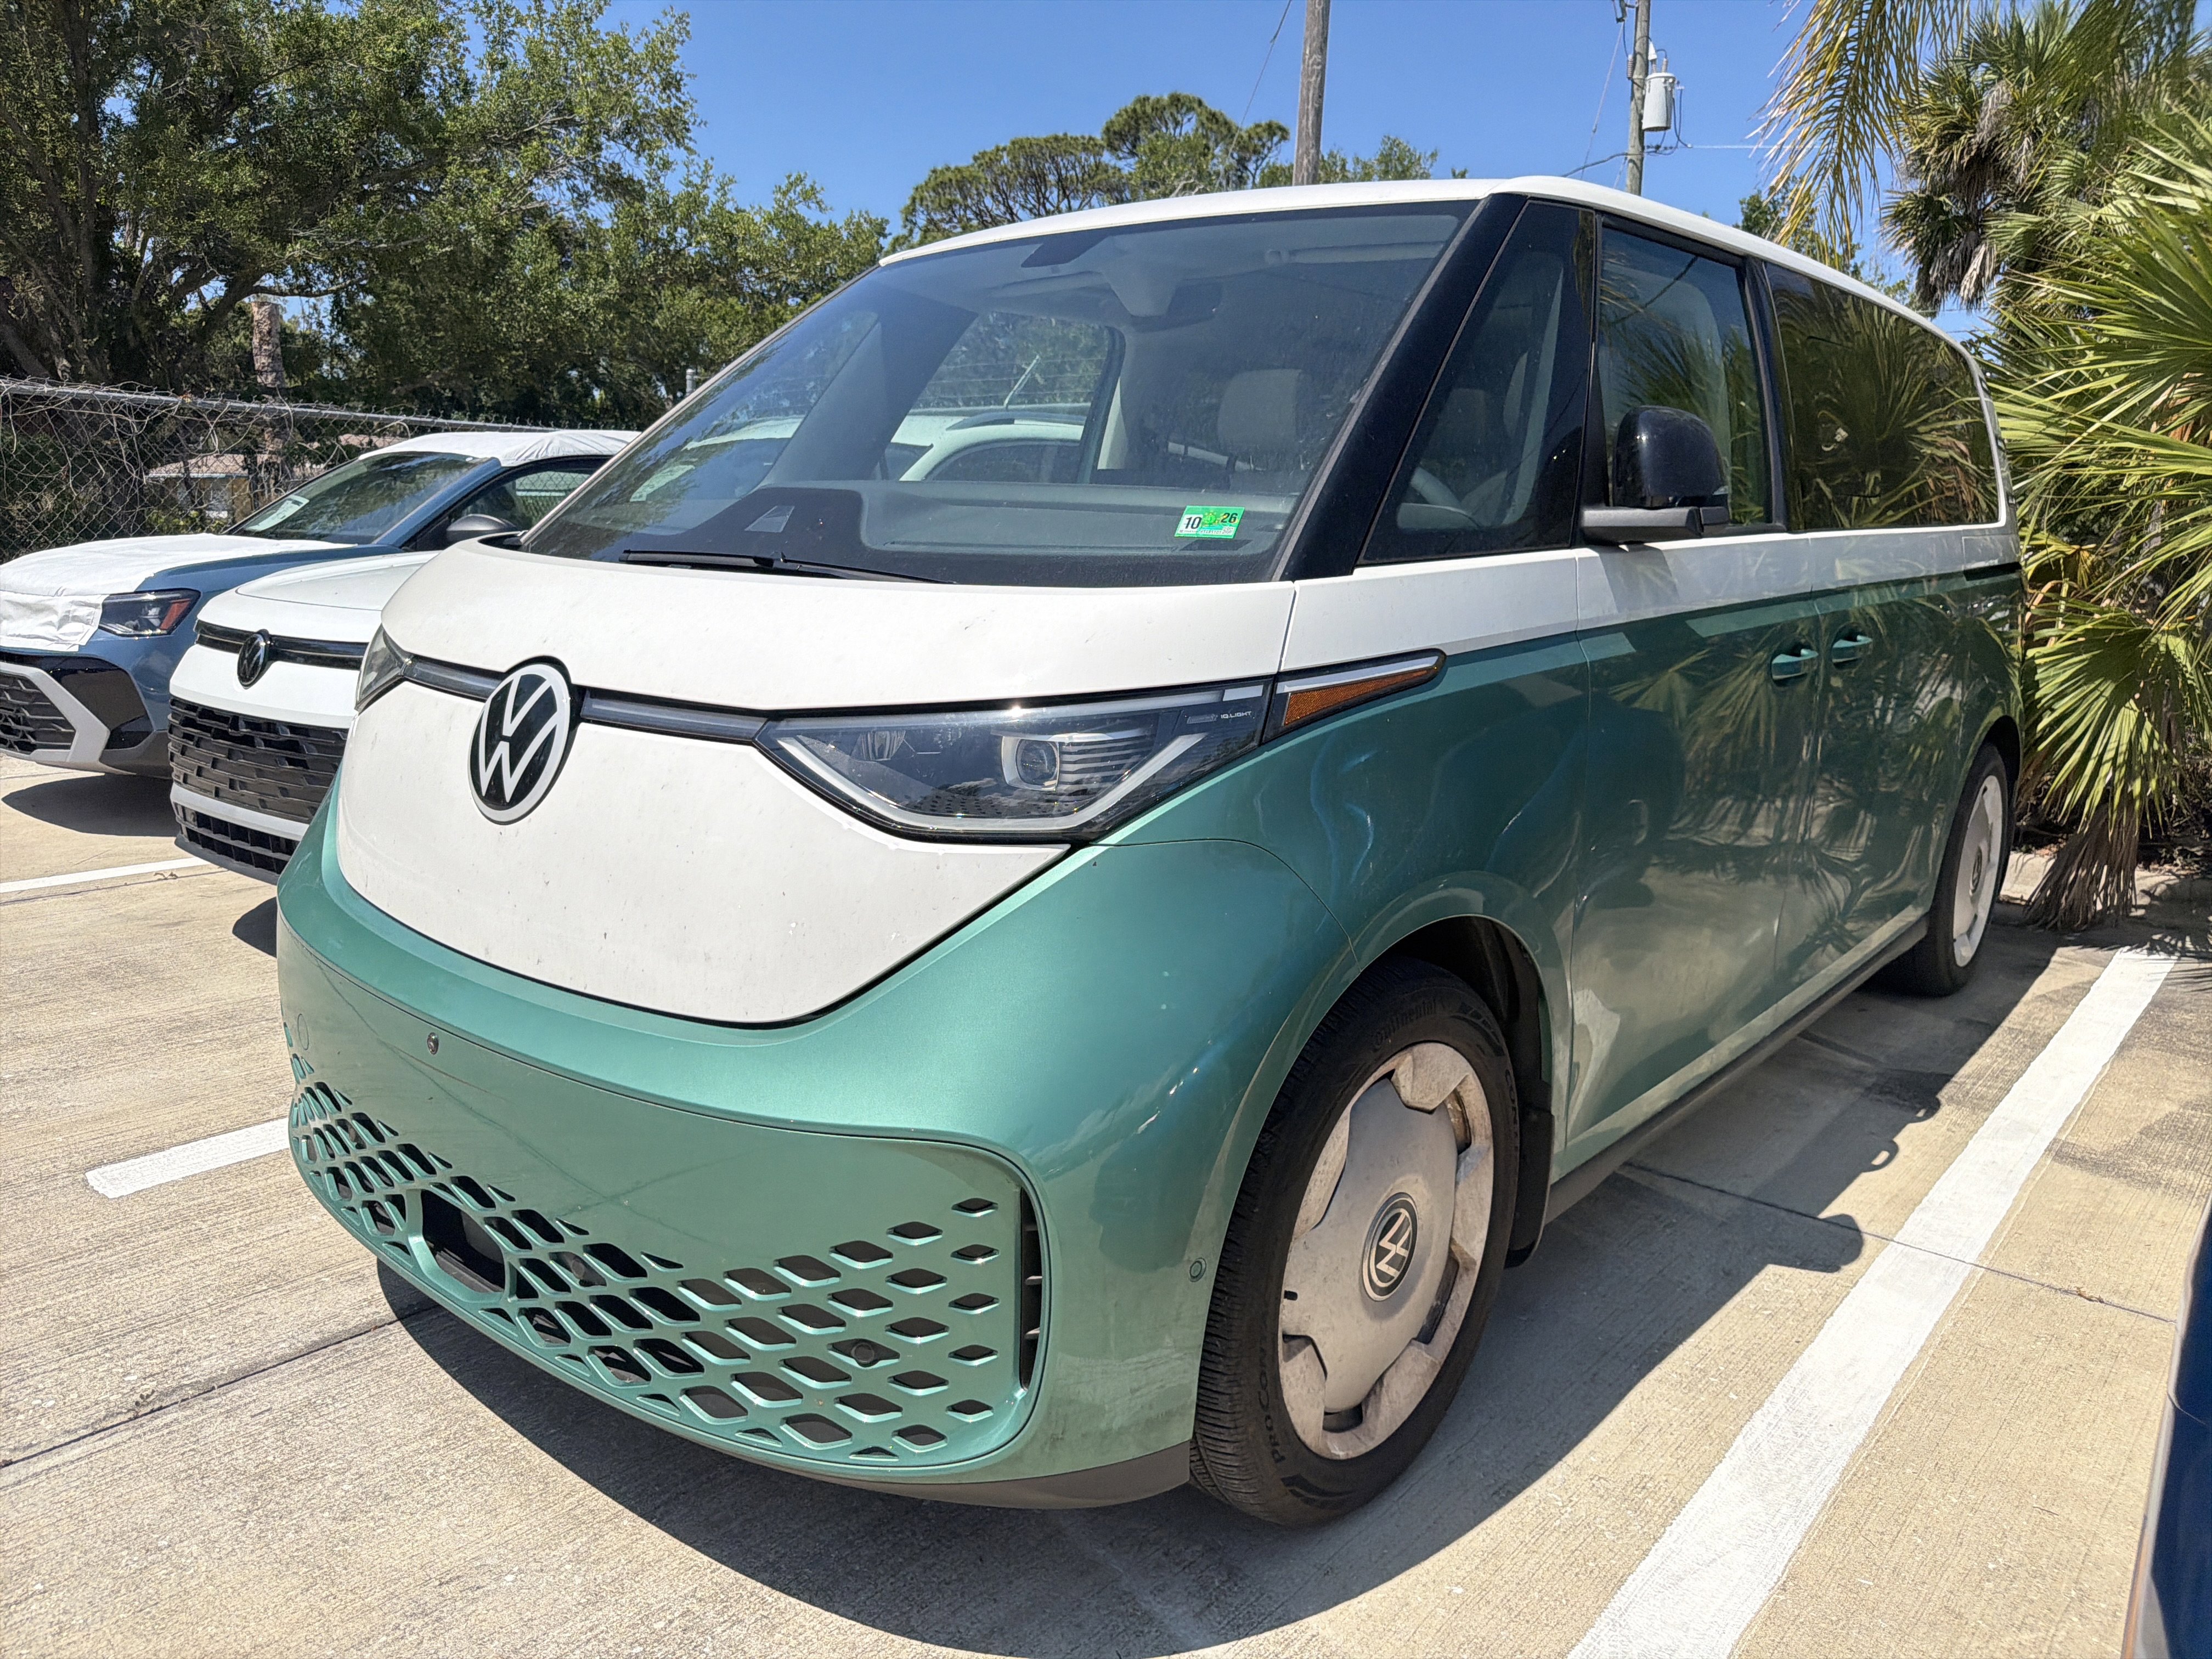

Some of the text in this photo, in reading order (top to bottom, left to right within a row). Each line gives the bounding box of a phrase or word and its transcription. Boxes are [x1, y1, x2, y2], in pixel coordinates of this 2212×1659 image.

[1186, 513, 1238, 529] 10 26
[475, 670, 562, 806] VW
[1373, 1209, 1412, 1283] VW
